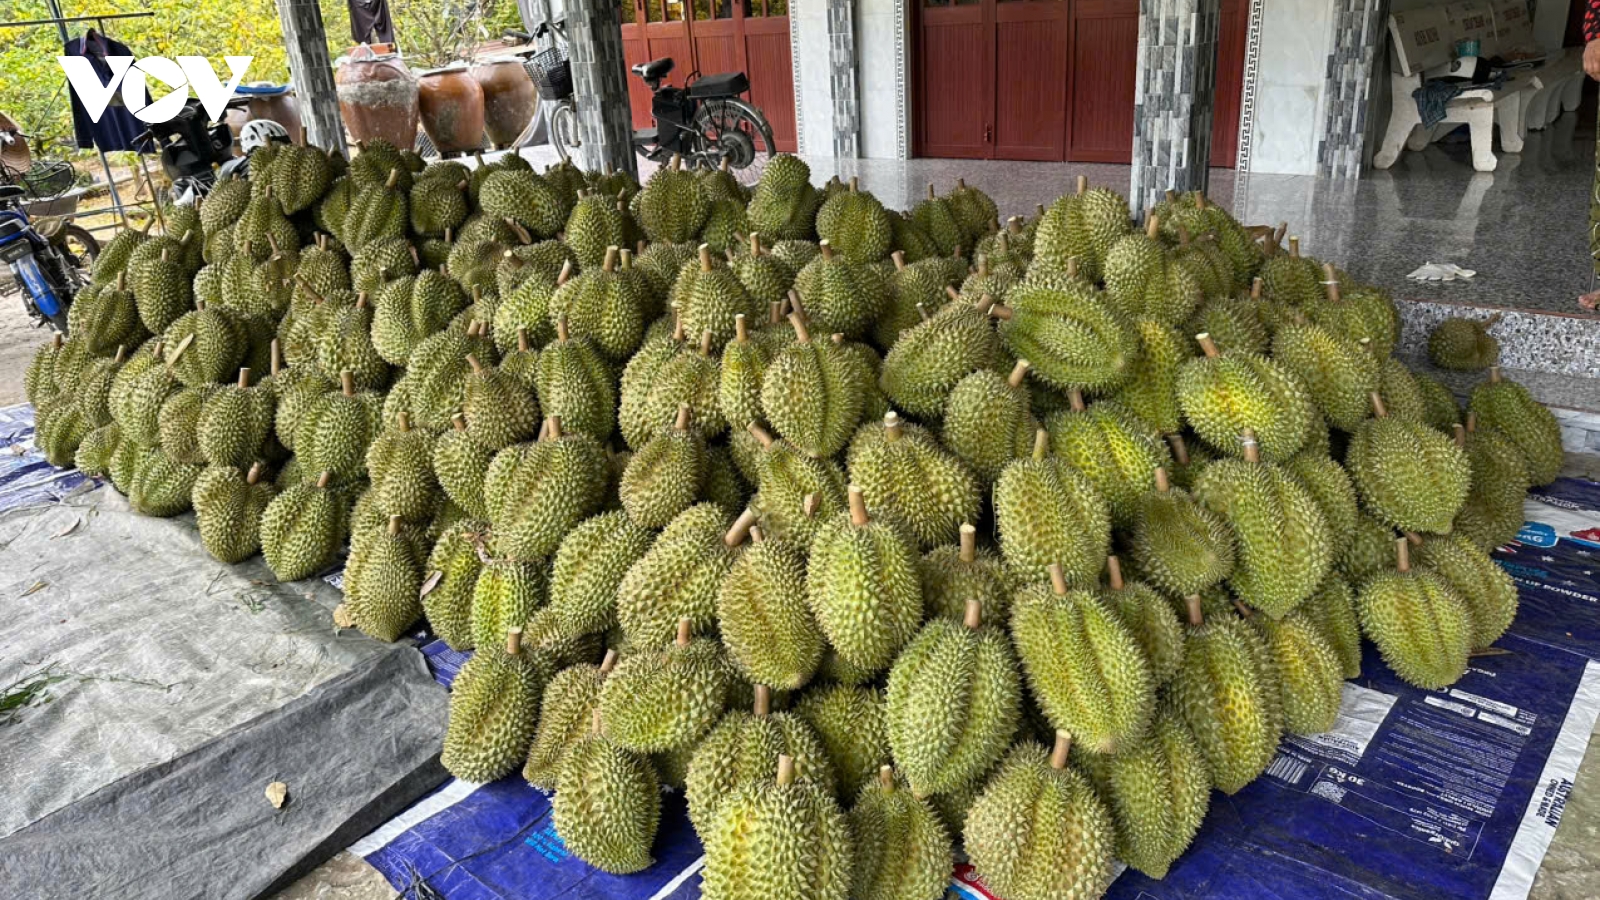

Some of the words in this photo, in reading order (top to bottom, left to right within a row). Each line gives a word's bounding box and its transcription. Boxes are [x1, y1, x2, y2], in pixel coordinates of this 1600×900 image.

[1543, 584, 1598, 602] POWDER
[1348, 775, 1366, 786] 30
[1544, 778, 1574, 828] AUSTRALIAN
